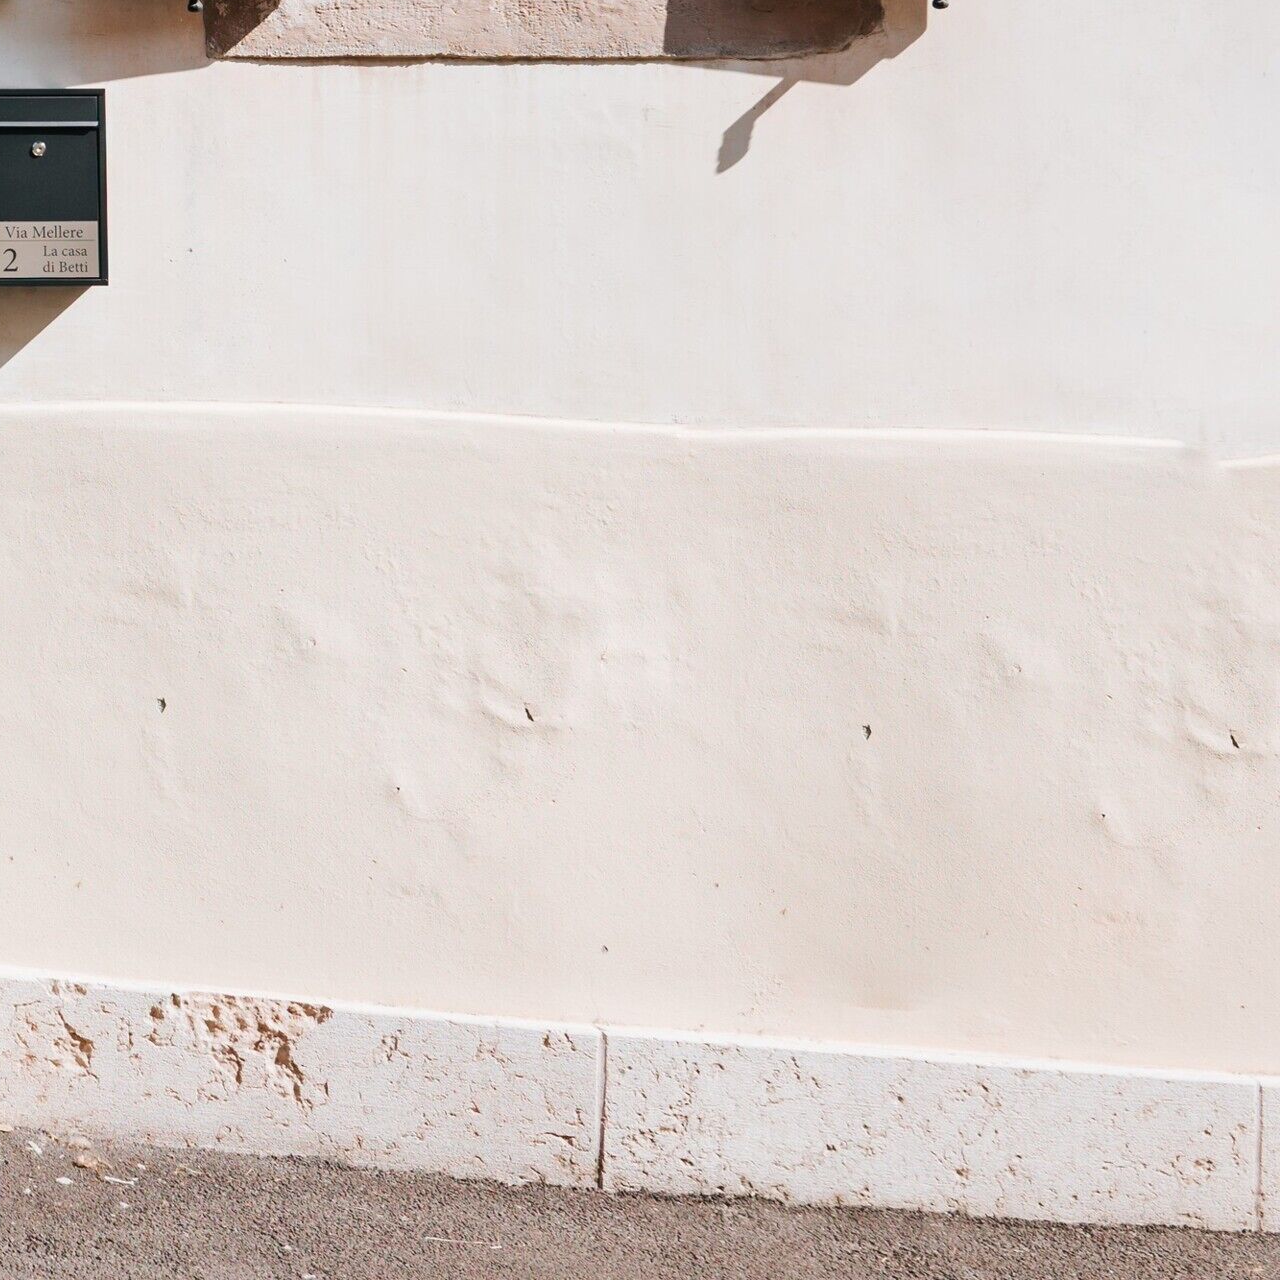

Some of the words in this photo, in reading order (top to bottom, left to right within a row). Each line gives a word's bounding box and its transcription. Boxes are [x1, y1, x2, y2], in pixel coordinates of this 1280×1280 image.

[5, 226, 28, 239] Via
[32, 225, 84, 239] Mellere
[43, 245, 58, 257] La
[61, 247, 88, 257] casa
[2, 248, 19, 272] 2
[42, 261, 55, 273] di
[59, 261, 88, 273] Betti
